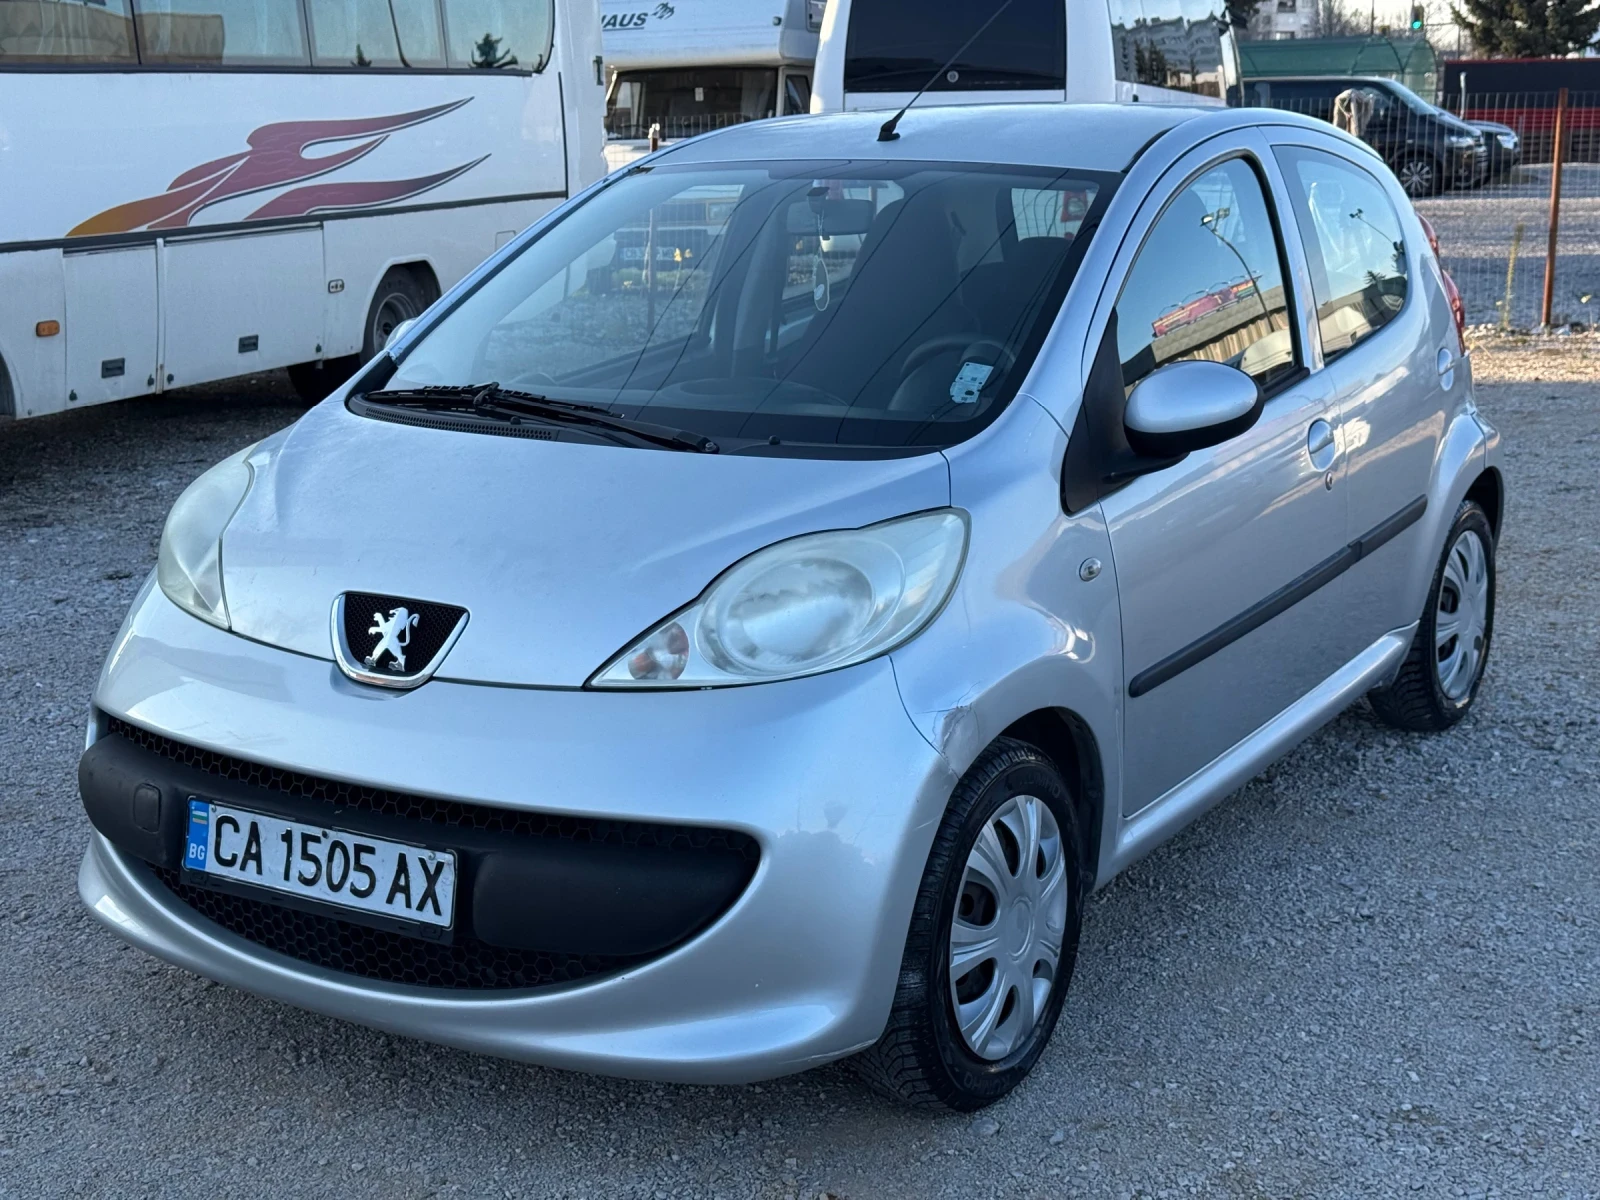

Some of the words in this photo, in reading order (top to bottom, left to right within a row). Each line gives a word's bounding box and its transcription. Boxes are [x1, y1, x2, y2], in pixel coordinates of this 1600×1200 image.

[188, 842, 206, 862] BG
[213, 815, 263, 876] CA
[280, 827, 377, 899] 1505
[385, 852, 445, 916] AX
